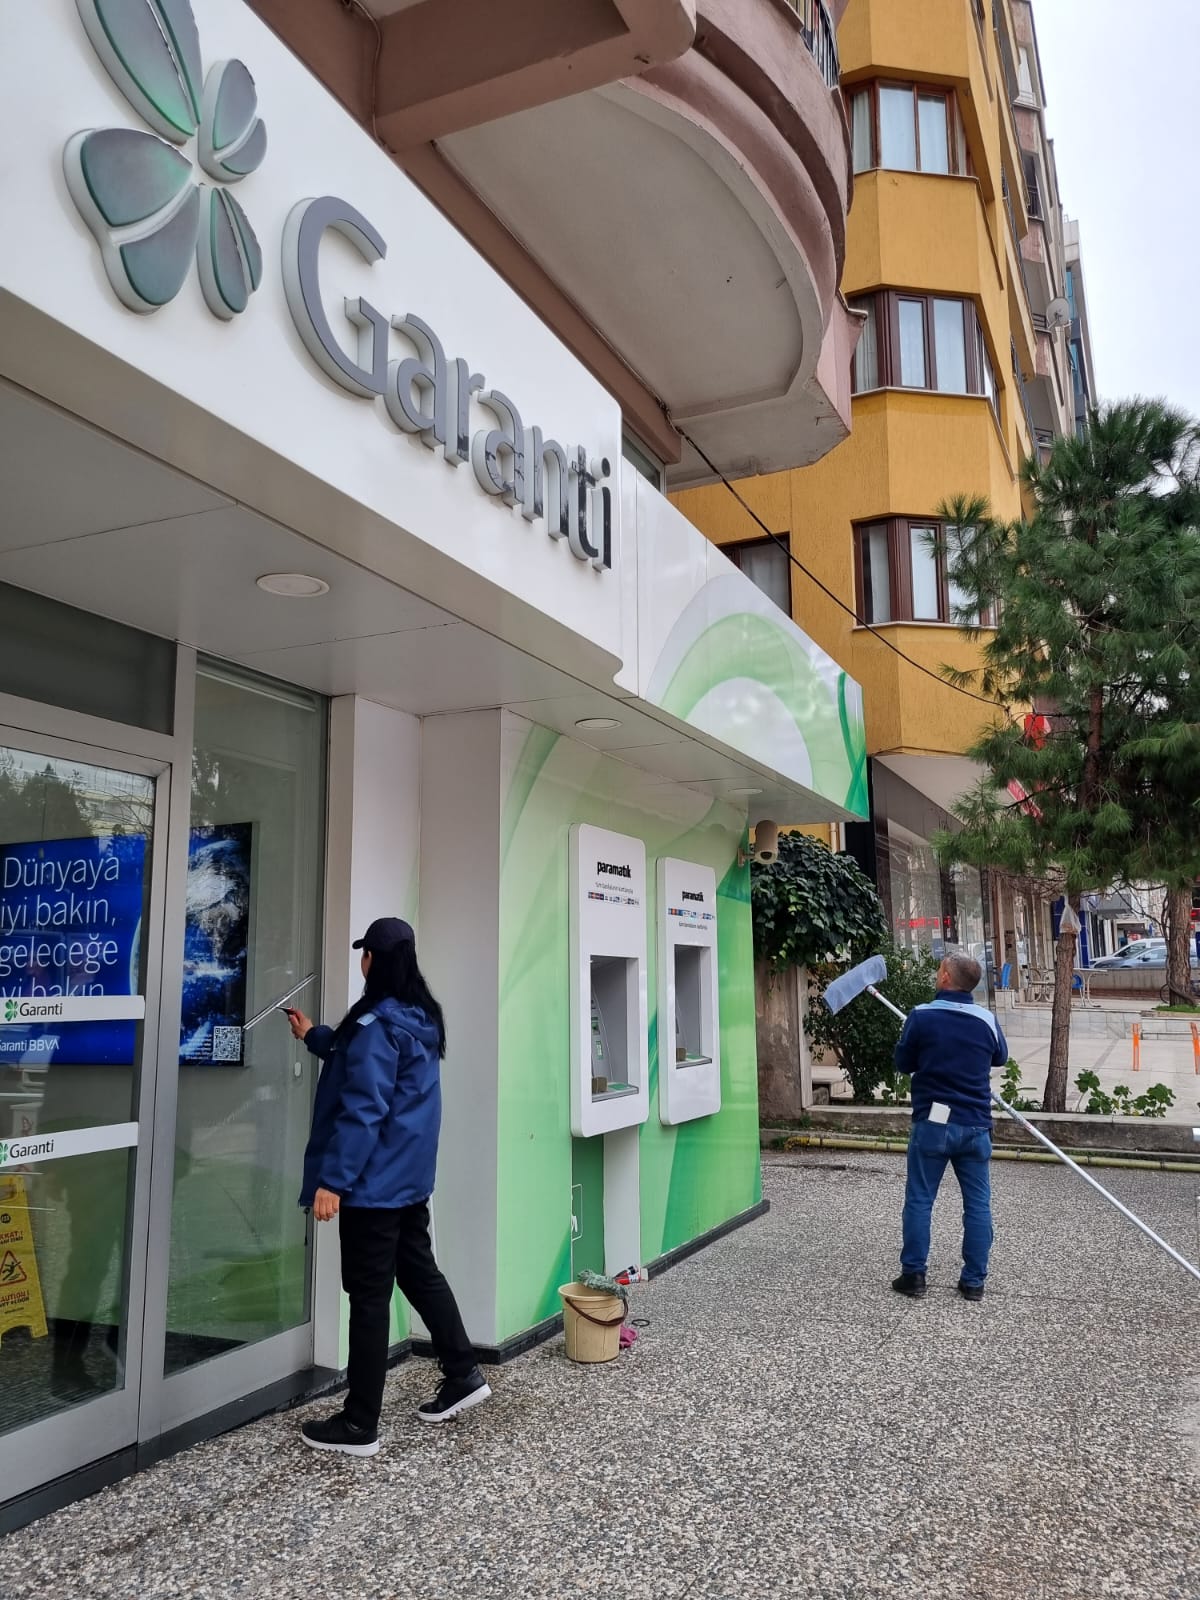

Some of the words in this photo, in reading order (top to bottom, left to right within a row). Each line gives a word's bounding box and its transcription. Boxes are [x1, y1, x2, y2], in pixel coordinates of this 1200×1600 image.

[282, 196, 612, 572] Garanti
[4, 856, 119, 892] Dünyaya
[1, 897, 28, 936] iyi
[36, 892, 116, 927] bakın,
[0, 933, 118, 977] geleceğe
[20, 1003, 63, 1017] Garanti
[0, 1040, 27, 1052] aranti
[29, 1038, 60, 1052] BBVA
[9, 1139, 54, 1158] Garanti
